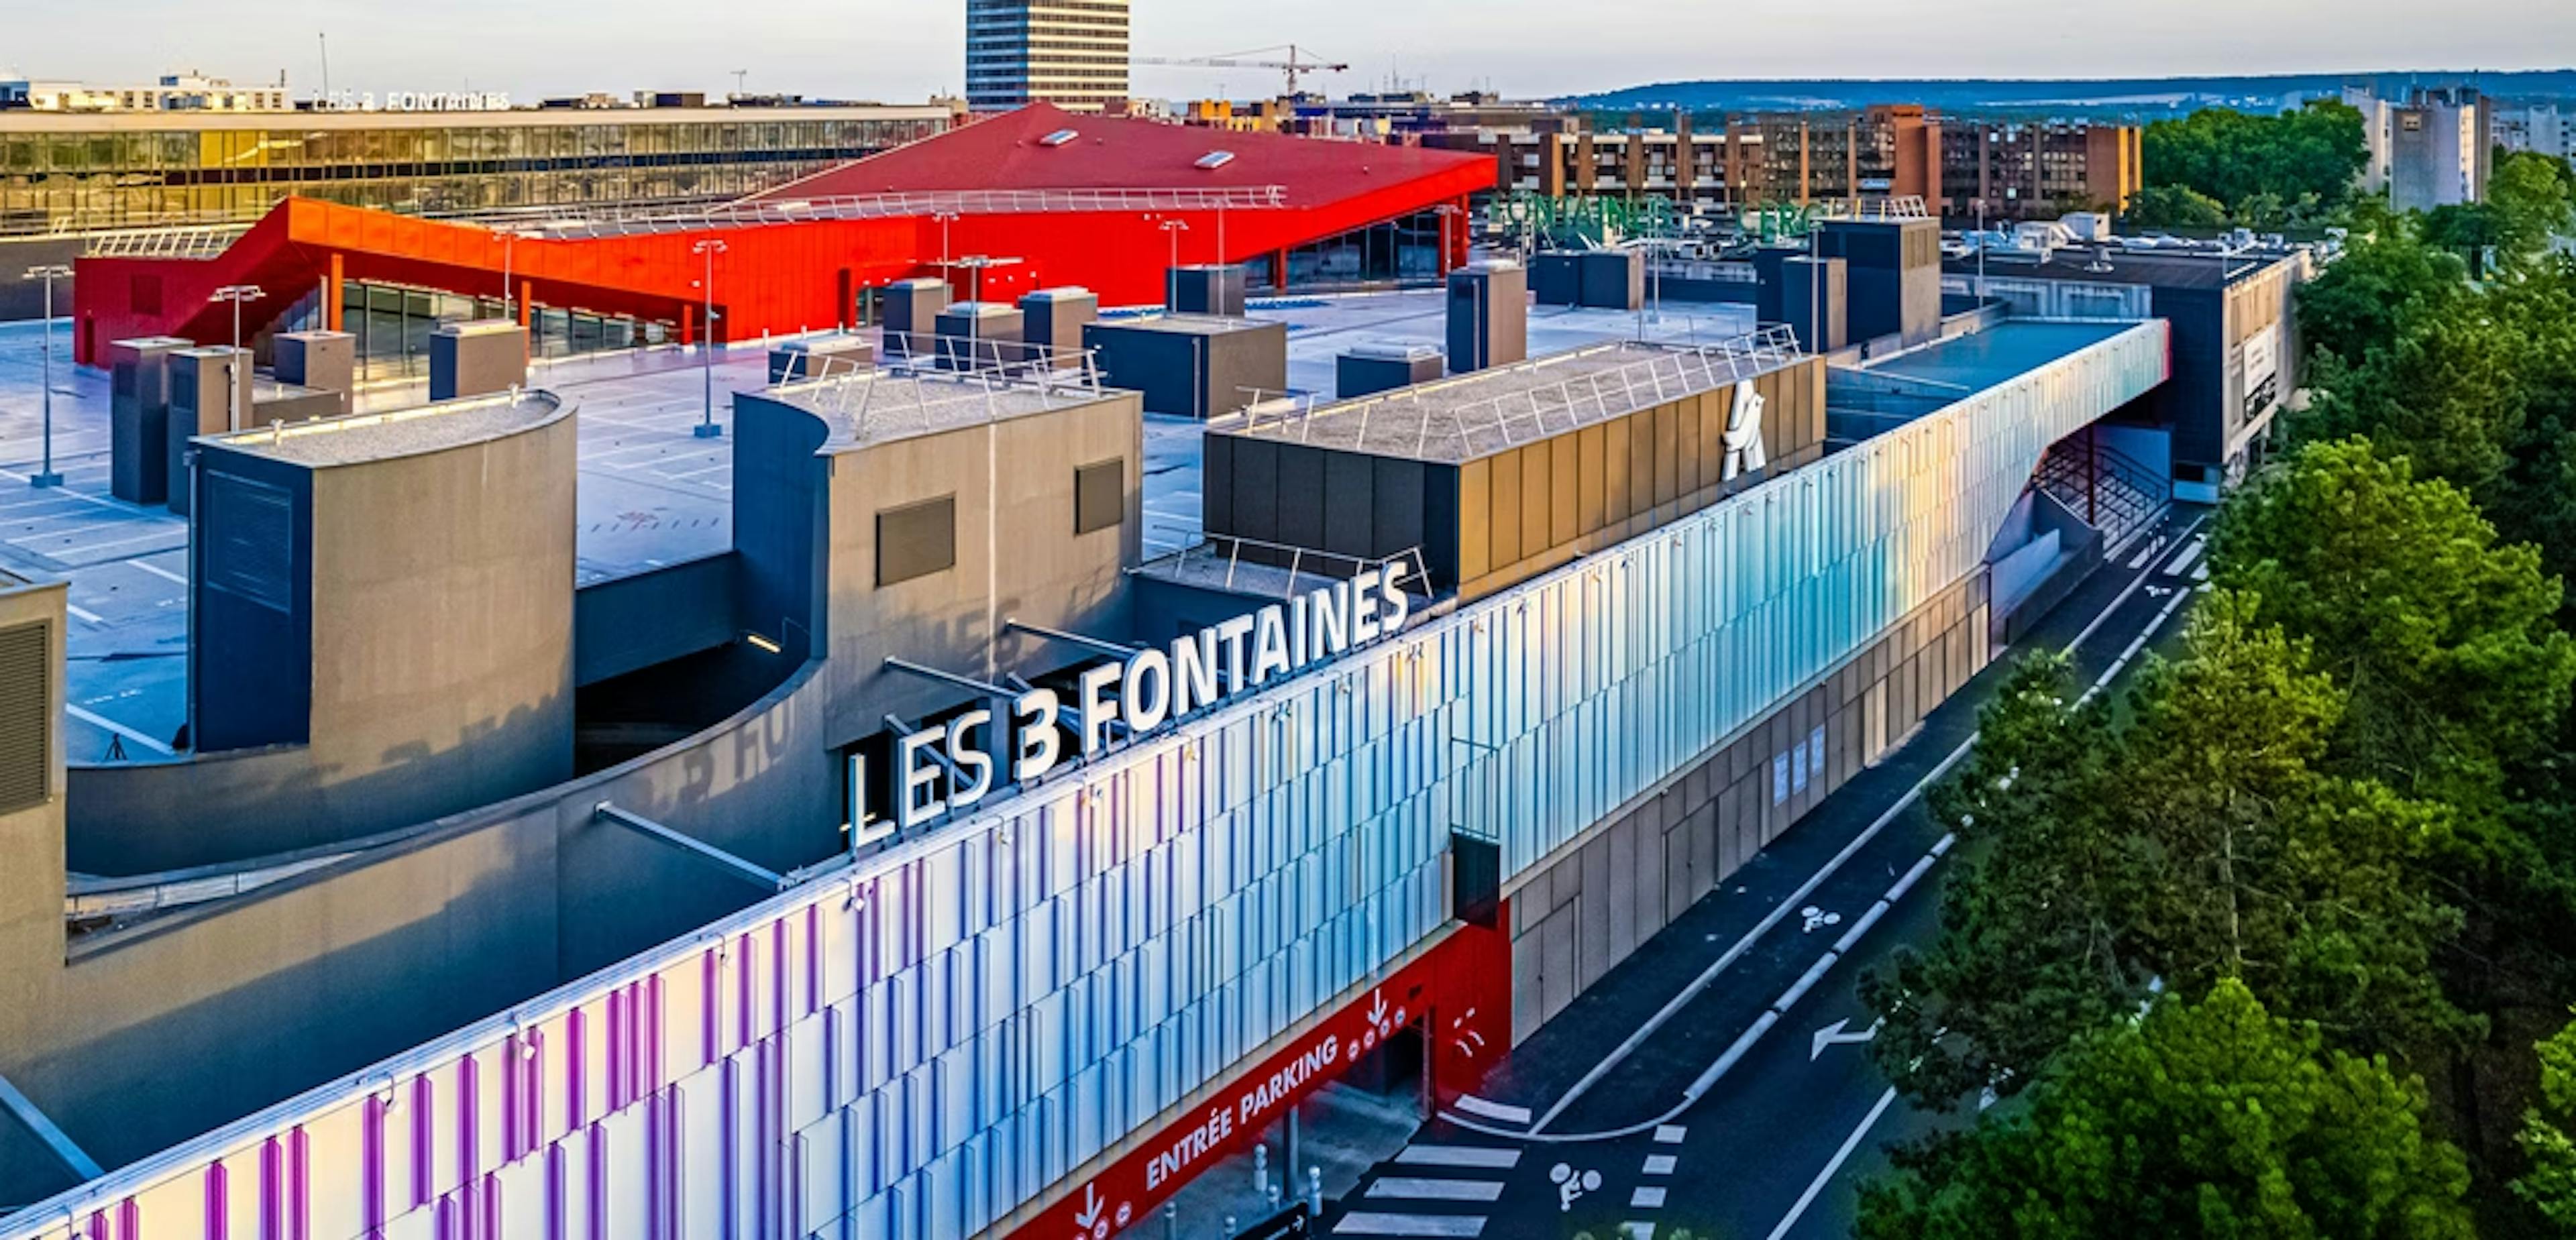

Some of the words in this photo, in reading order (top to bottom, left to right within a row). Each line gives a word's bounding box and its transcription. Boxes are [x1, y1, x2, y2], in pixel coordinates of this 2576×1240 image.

[386, 92, 511, 111] FONTAINES
[849, 709, 993, 848] LES
[1014, 688, 1060, 779] 3
[1080, 561, 1409, 755] FONTAINES
[1146, 1105, 1232, 1191] ENTRÉE
[1240, 1034, 1338, 1125] PARKING
